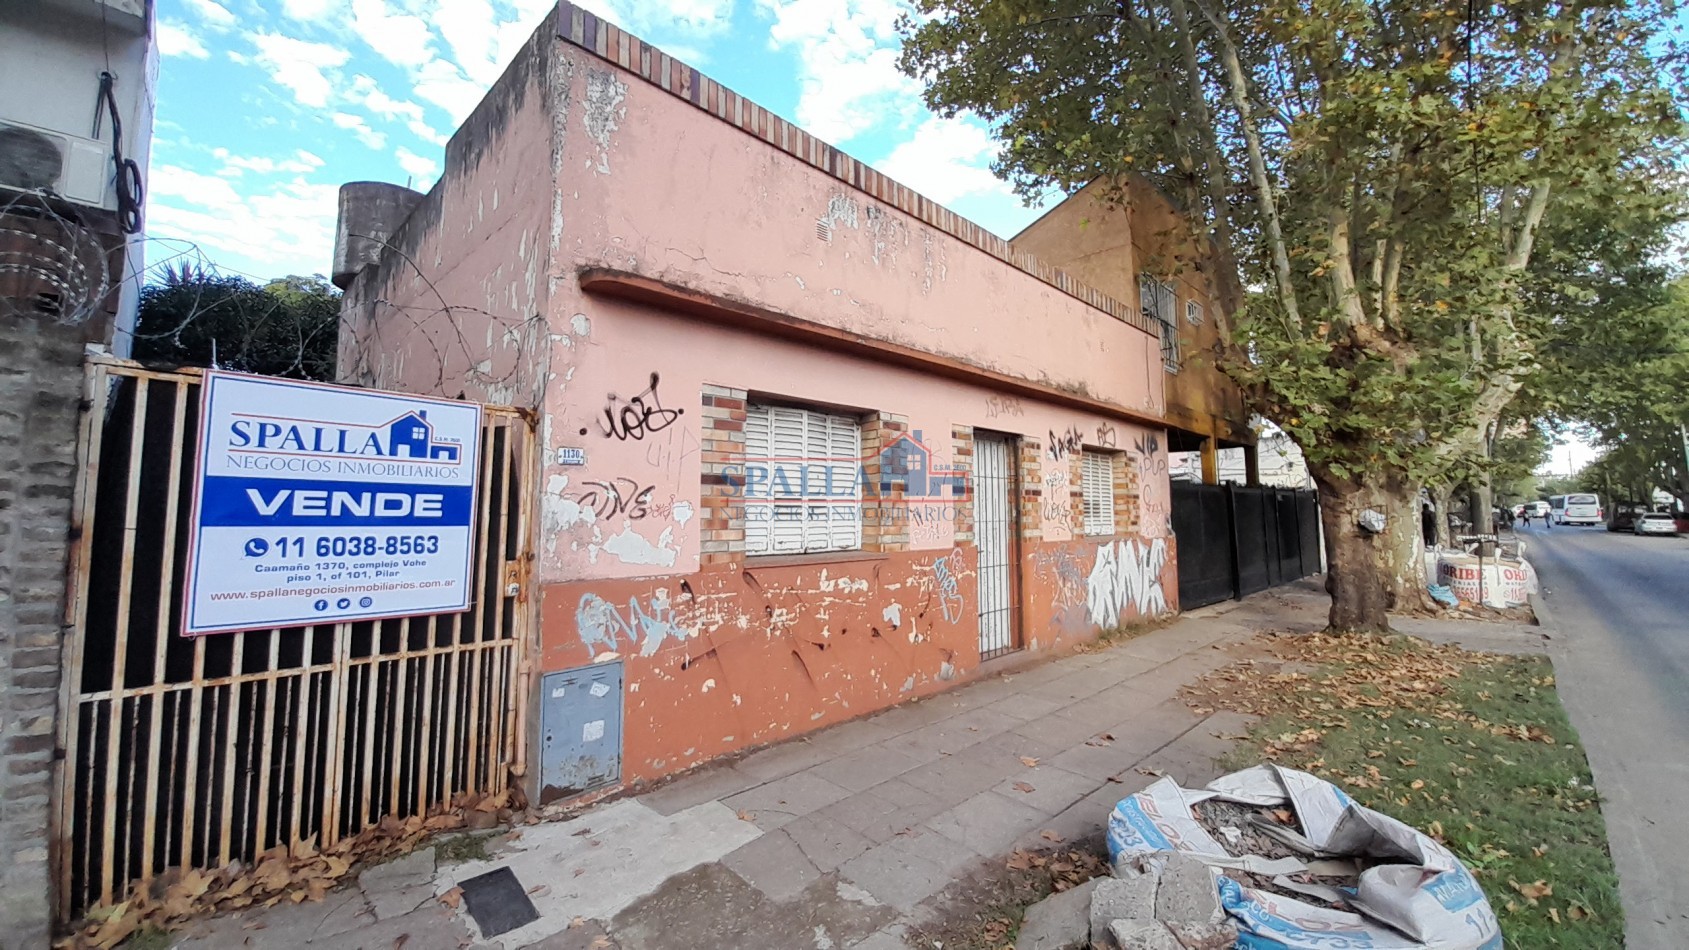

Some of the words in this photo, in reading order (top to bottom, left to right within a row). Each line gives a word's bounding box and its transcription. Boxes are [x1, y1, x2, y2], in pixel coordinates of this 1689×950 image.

[229, 420, 386, 457] SPALLA
[563, 449, 580, 459] 1130
[226, 454, 332, 473] NEGOCIOS
[337, 459, 459, 479] INMOBILIARIOS
[246, 488, 444, 517] VENDE
[275, 536, 305, 558] 11
[315, 535, 439, 557] 6038-8563
[286, 573, 311, 583] piso
[316, 573, 327, 581] 1,
[331, 571, 343, 580] of
[346, 571, 372, 579] 101,
[375, 570, 400, 578] Pilar
[315, 561, 349, 572] 1370,
[353, 560, 399, 571] complejo
[210, 579, 456, 601] www.spallanegociosinmobiliarios.com.ar
